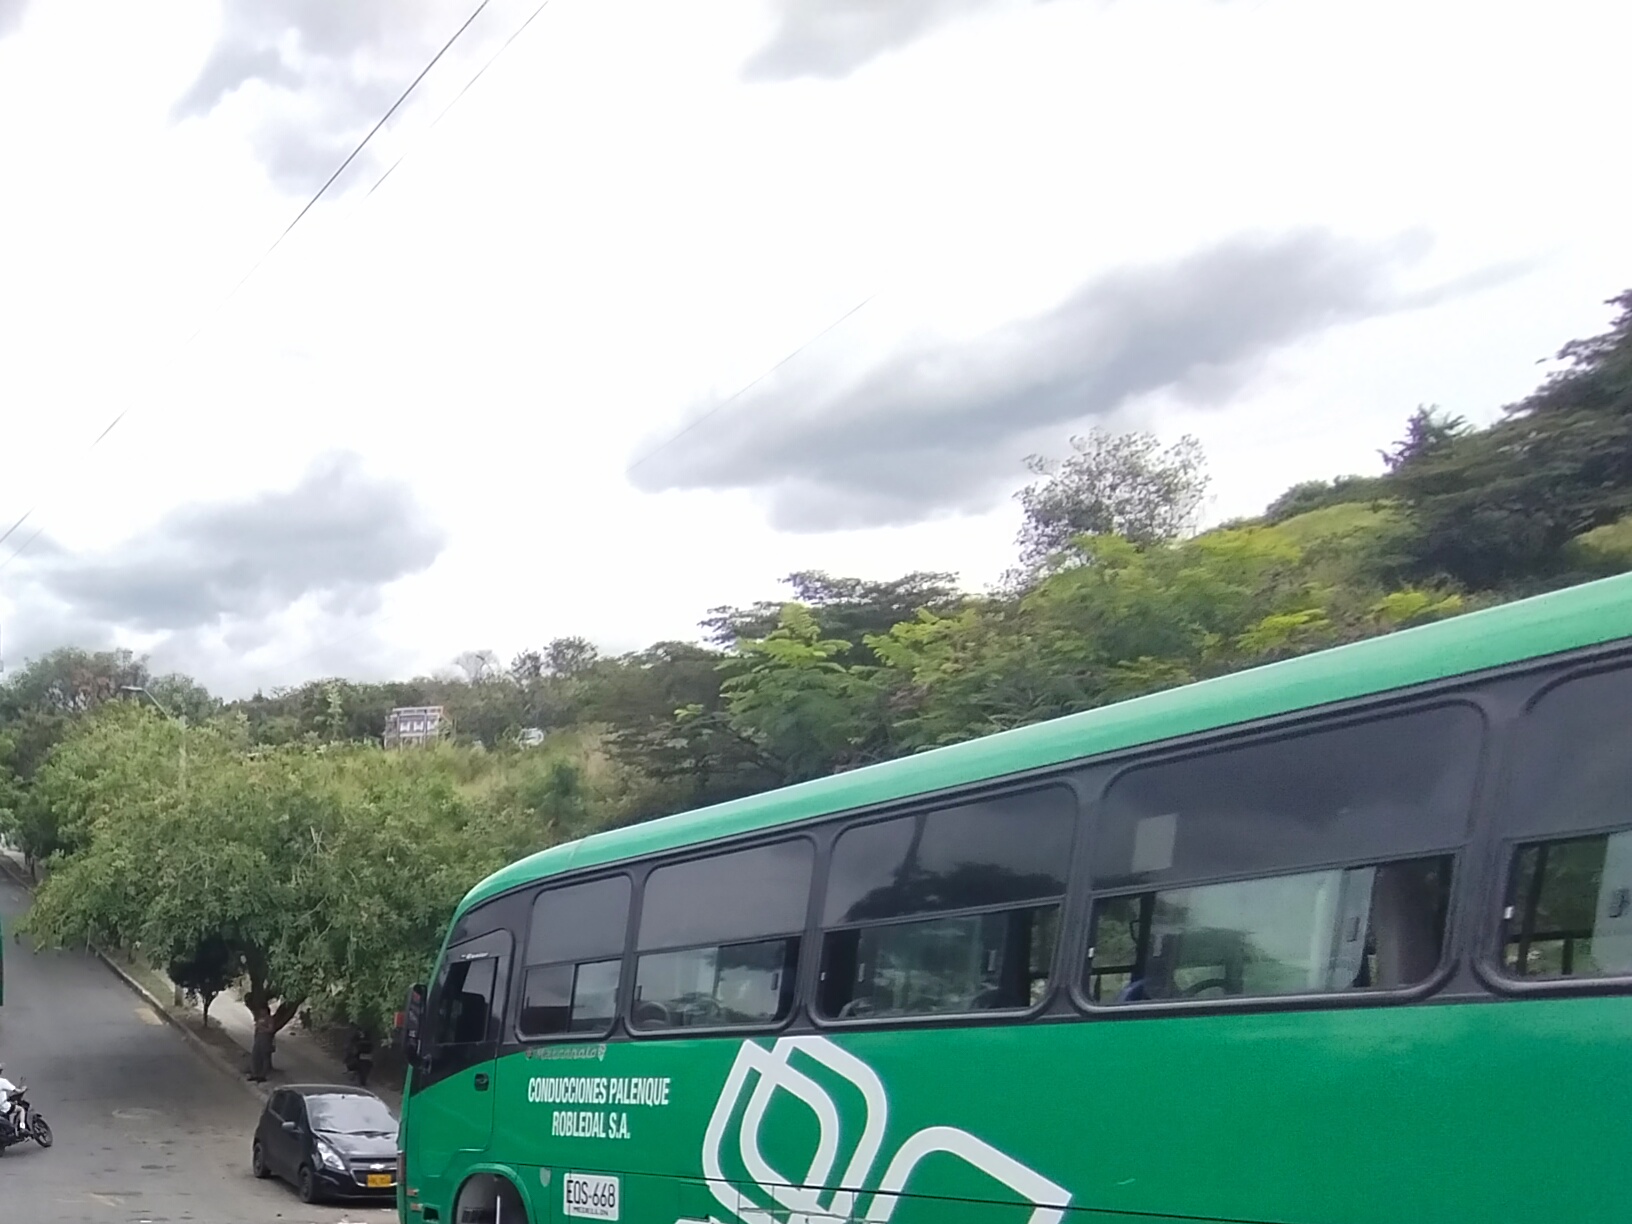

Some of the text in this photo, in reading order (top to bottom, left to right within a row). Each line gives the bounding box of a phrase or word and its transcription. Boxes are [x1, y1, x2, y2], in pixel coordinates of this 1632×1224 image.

[528, 1077, 670, 1107] CONDUCCIONES PALENQUE
[552, 1111, 631, 1139] ROBLEDAL S.A.
